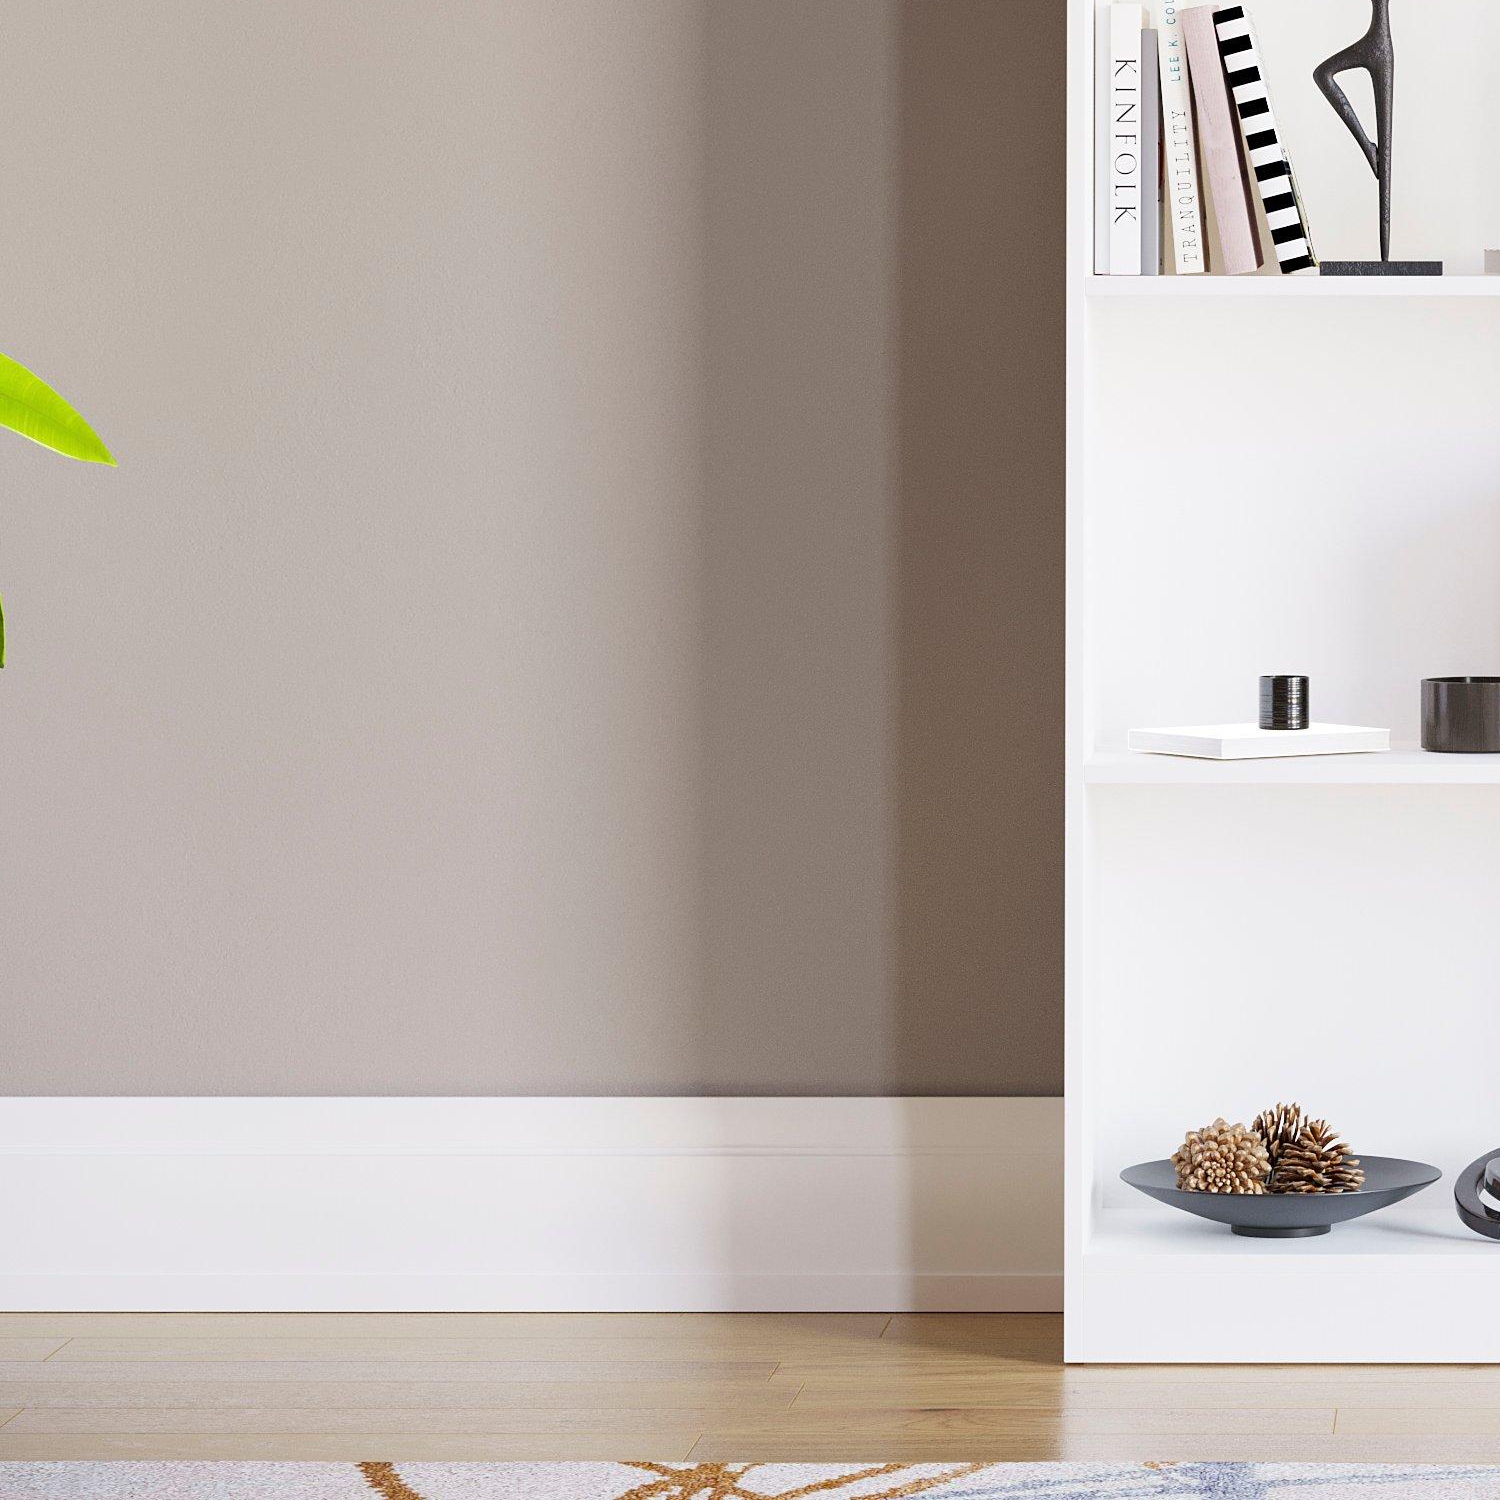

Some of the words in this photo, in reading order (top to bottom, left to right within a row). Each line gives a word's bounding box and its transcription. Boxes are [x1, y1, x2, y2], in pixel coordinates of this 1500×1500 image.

[1168, 34, 1178, 47] K.
[1169, 56, 1181, 82] LEE
[1113, 59, 1137, 226] KINFOLK
[1171, 109, 1199, 263] TRANQUILITY
